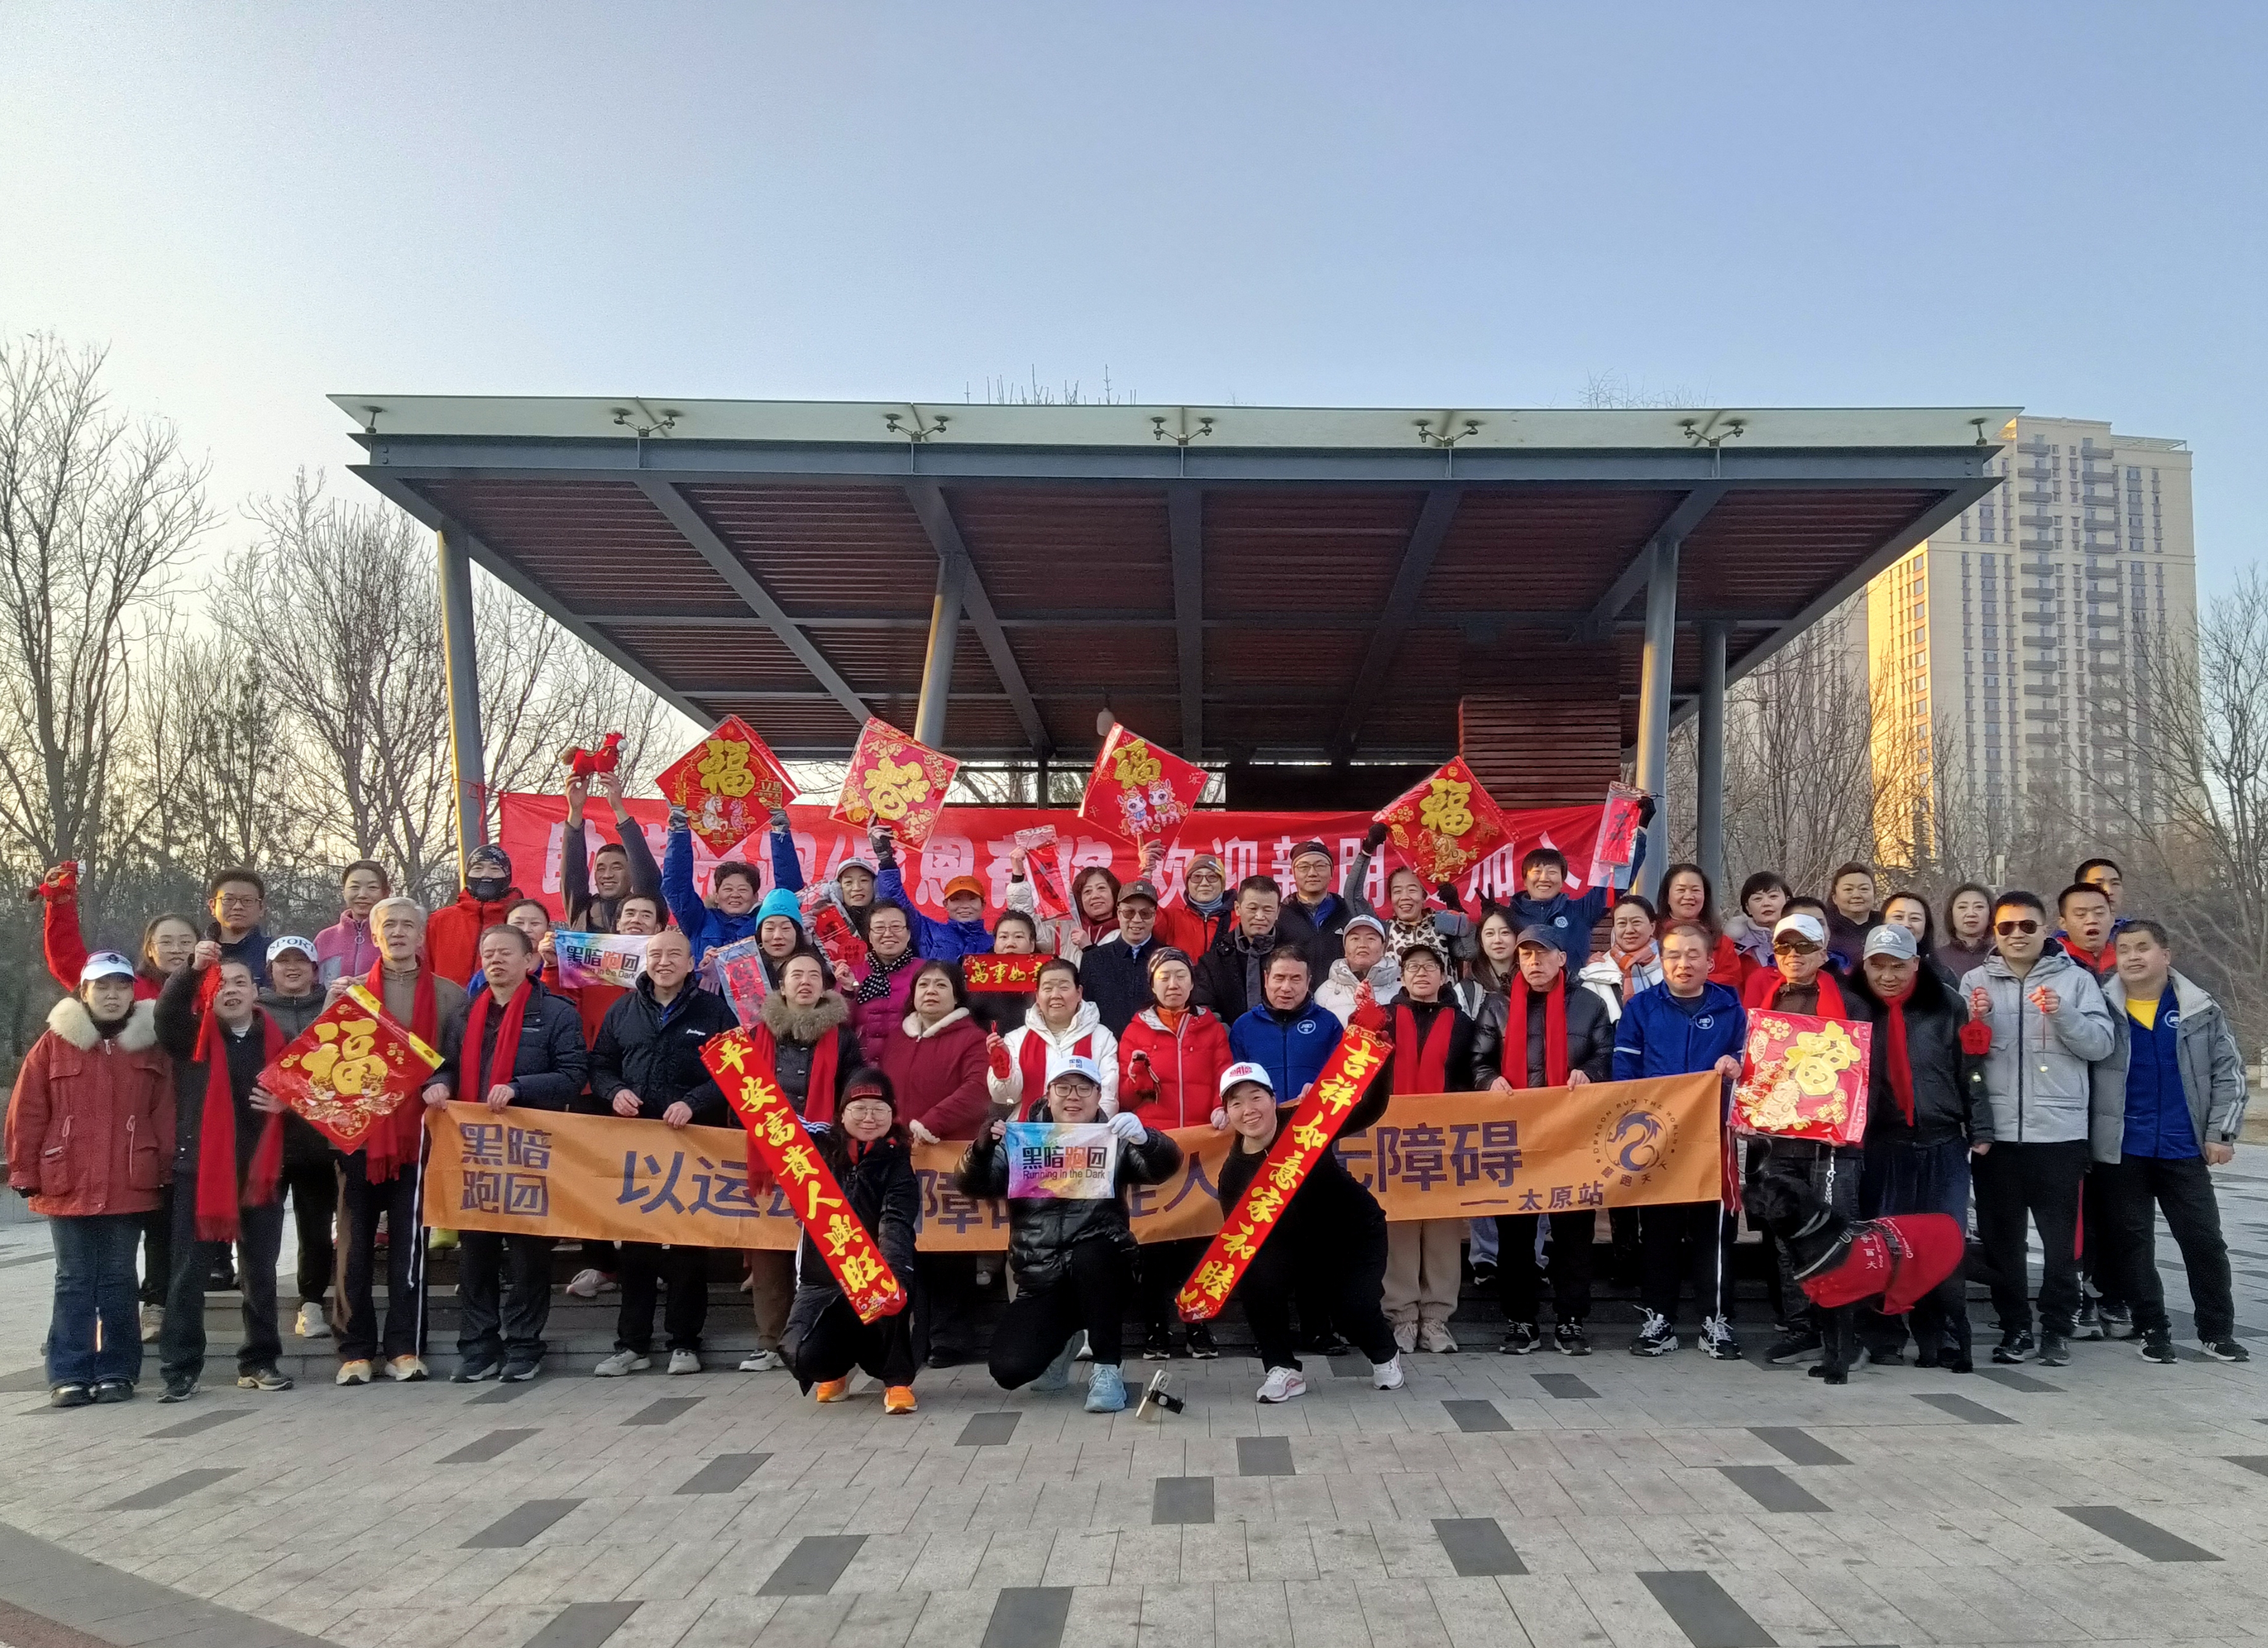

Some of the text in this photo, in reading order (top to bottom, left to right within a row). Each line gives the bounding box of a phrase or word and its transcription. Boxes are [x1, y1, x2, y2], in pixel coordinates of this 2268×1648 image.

[697, 739, 756, 797] 福
[922, 753, 949, 790] 马年吉祥
[1111, 738, 1162, 789] 福
[1420, 778, 1474, 836] 福
[618, 970, 636, 980] Dark
[301, 1018, 388, 1095] 福
[1783, 1020, 1862, 1096] 福
[459, 1122, 553, 1170] 黑暗
[1593, 1098, 1679, 1154] DRAGON RUN THE WORLD
[1022, 1146, 1107, 1170] 黑暗跑团
[1022, 1167, 1106, 1181] Running in the Dark
[459, 1171, 548, 1217] 跑团
